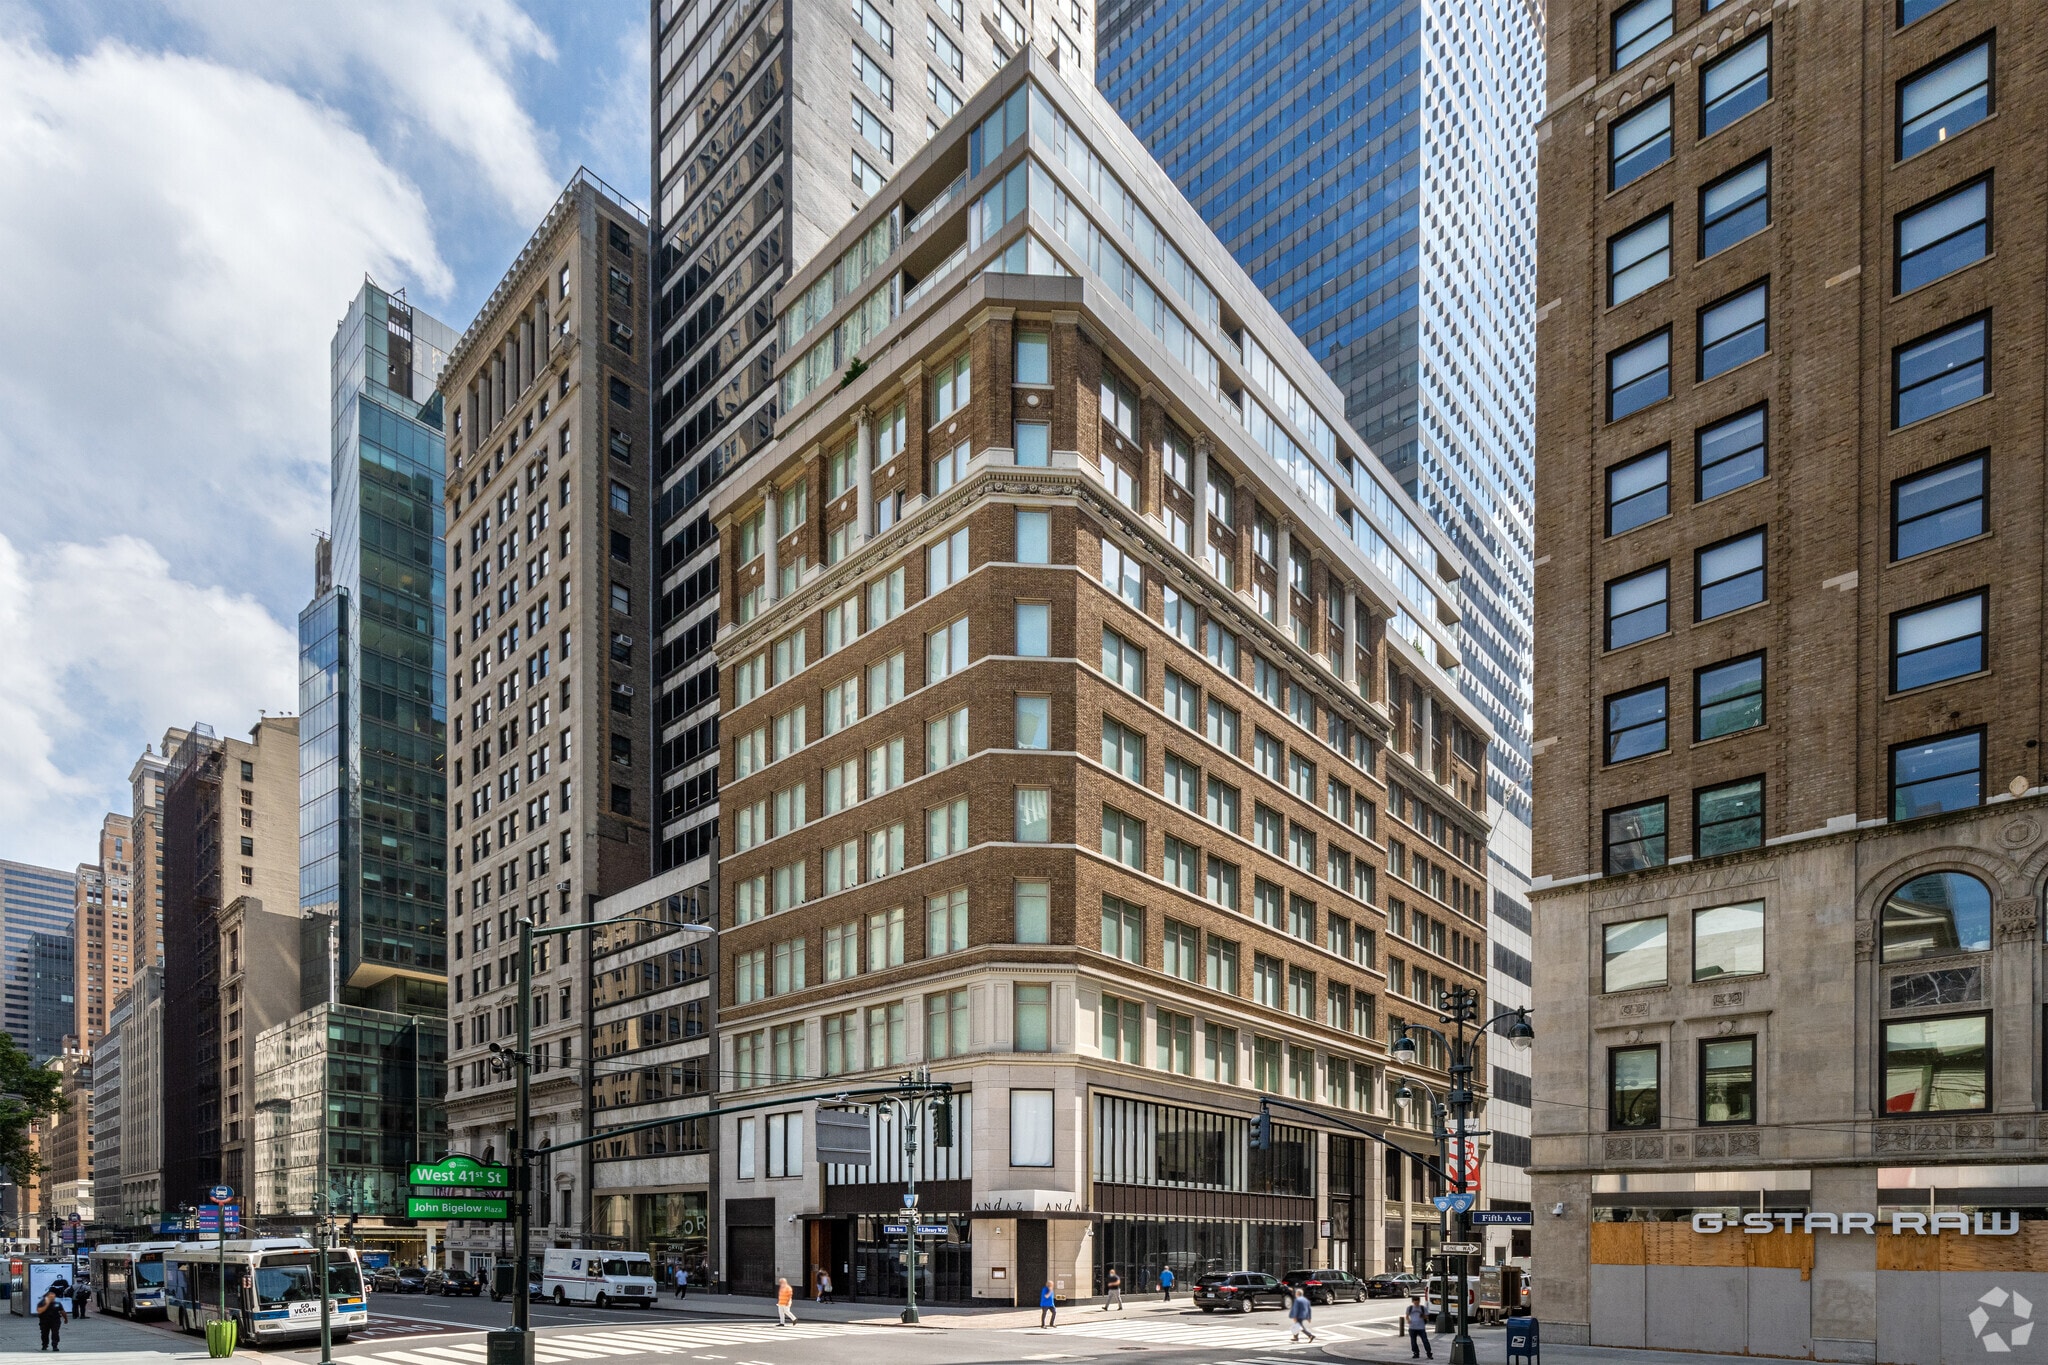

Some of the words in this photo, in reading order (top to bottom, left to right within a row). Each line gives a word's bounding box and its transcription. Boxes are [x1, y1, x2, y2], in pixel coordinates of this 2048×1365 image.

[417, 1168, 455, 1182] West
[458, 1170, 484, 1182] 41st
[487, 1171, 502, 1184] St
[414, 1202, 439, 1212] John
[442, 1203, 482, 1215] Bigelow
[1481, 1214, 1503, 1222] Fifth
[1504, 1214, 1522, 1222] Ave
[1692, 1212, 1876, 1235] G-STAR
[1892, 1211, 2020, 1236] RAW
